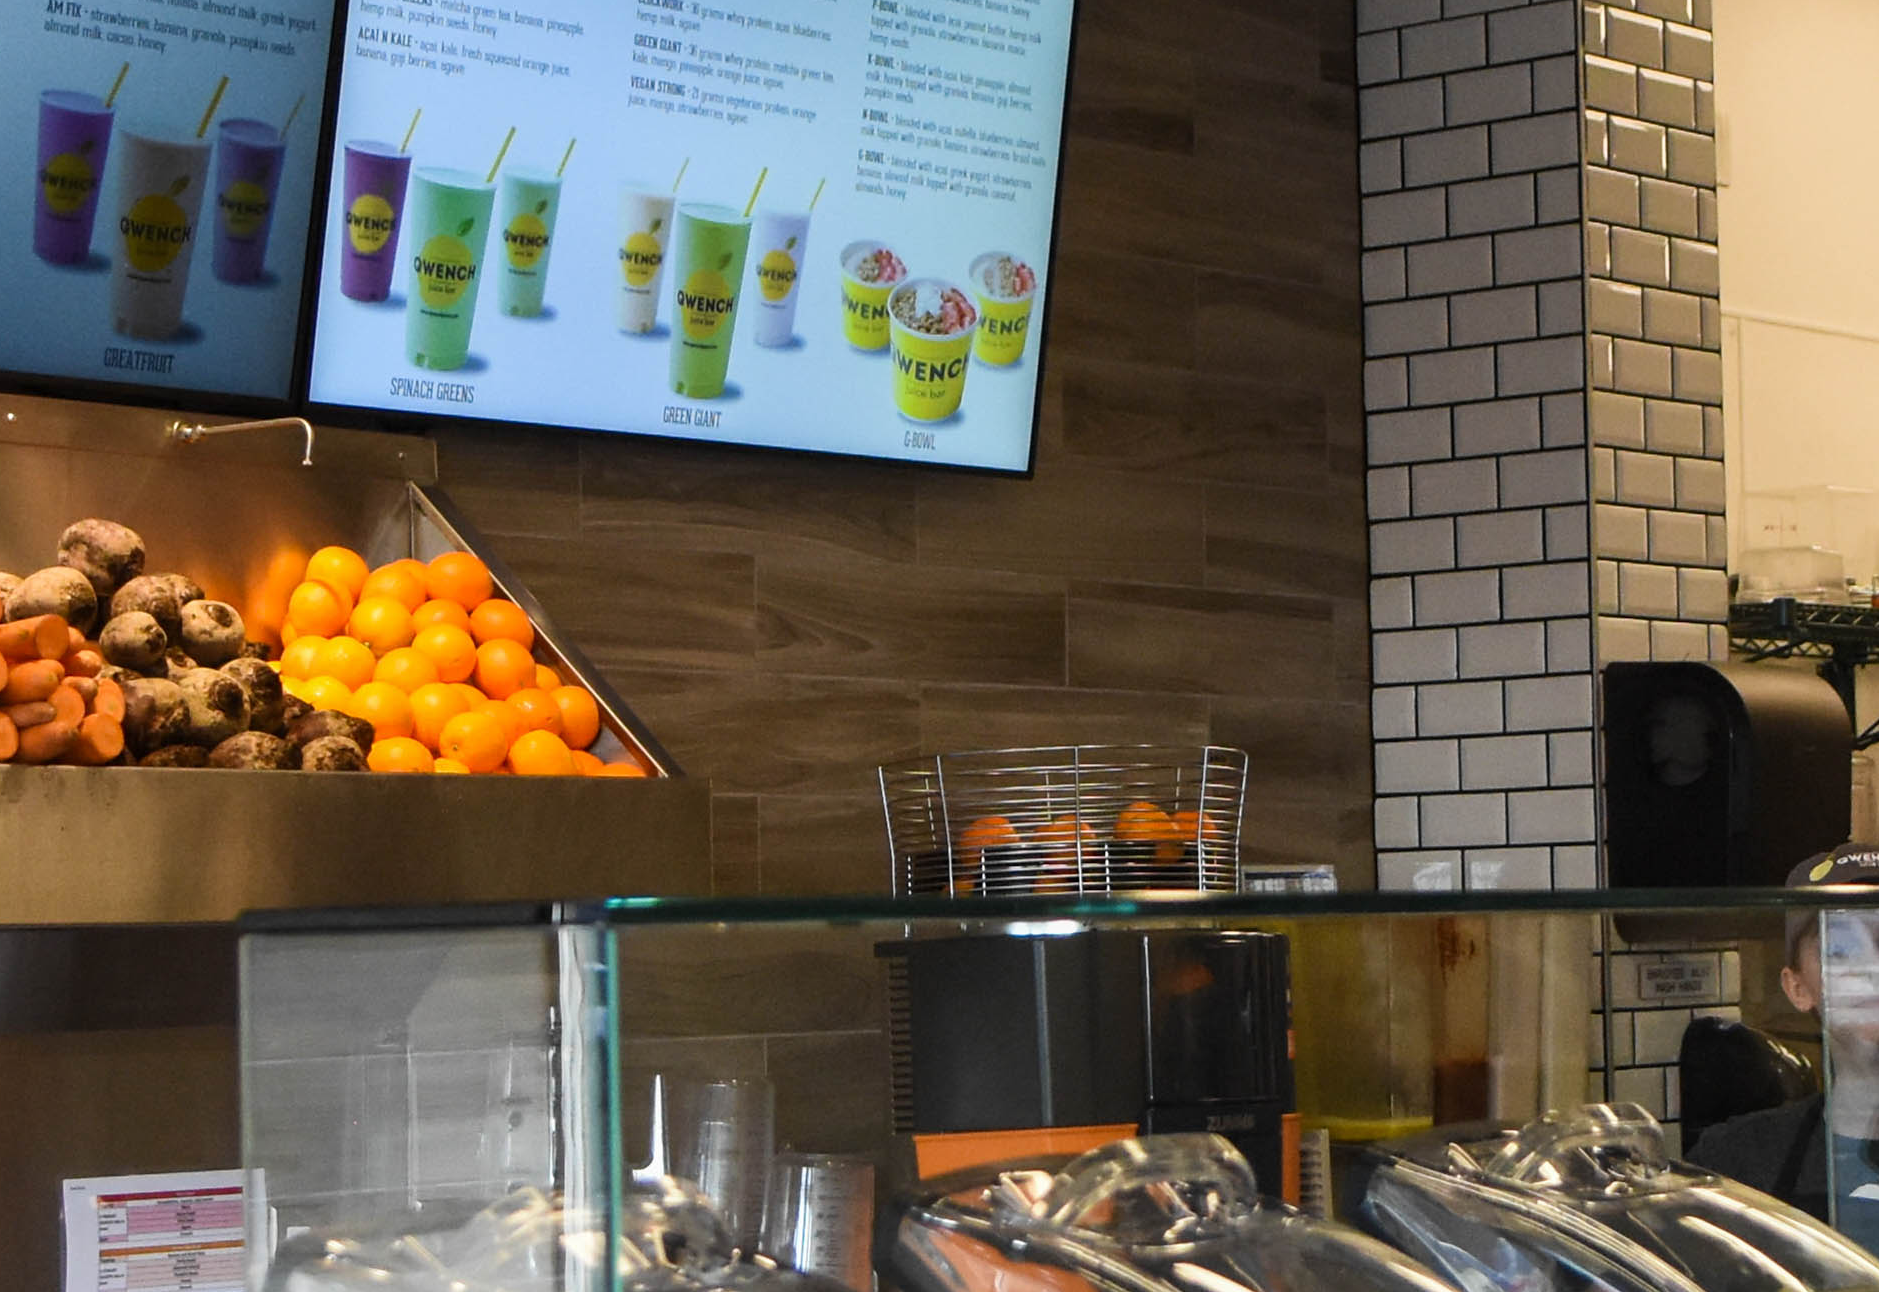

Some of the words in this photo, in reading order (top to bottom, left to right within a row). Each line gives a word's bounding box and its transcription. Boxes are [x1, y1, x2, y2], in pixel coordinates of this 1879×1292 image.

[64, 1, 83, 19] FIX
[389, 31, 413, 49] KALE
[632, 32, 659, 50] GREEN
[658, 37, 683, 55] GIANT
[629, 74, 656, 92] VEGAN
[656, 79, 686, 98] STRONG
[118, 214, 193, 245] QWENCH
[501, 228, 550, 249] QWENCH
[412, 255, 478, 284] QWENCH
[676, 289, 735, 315] QWENCH
[102, 346, 176, 375] GREATFRUIT
[388, 374, 434, 401] SPINACH
[435, 379, 475, 405] GREENS
[661, 403, 693, 426] GREEN
[692, 406, 723, 429] GIANT
[902, 429, 937, 450] G-BOWL
